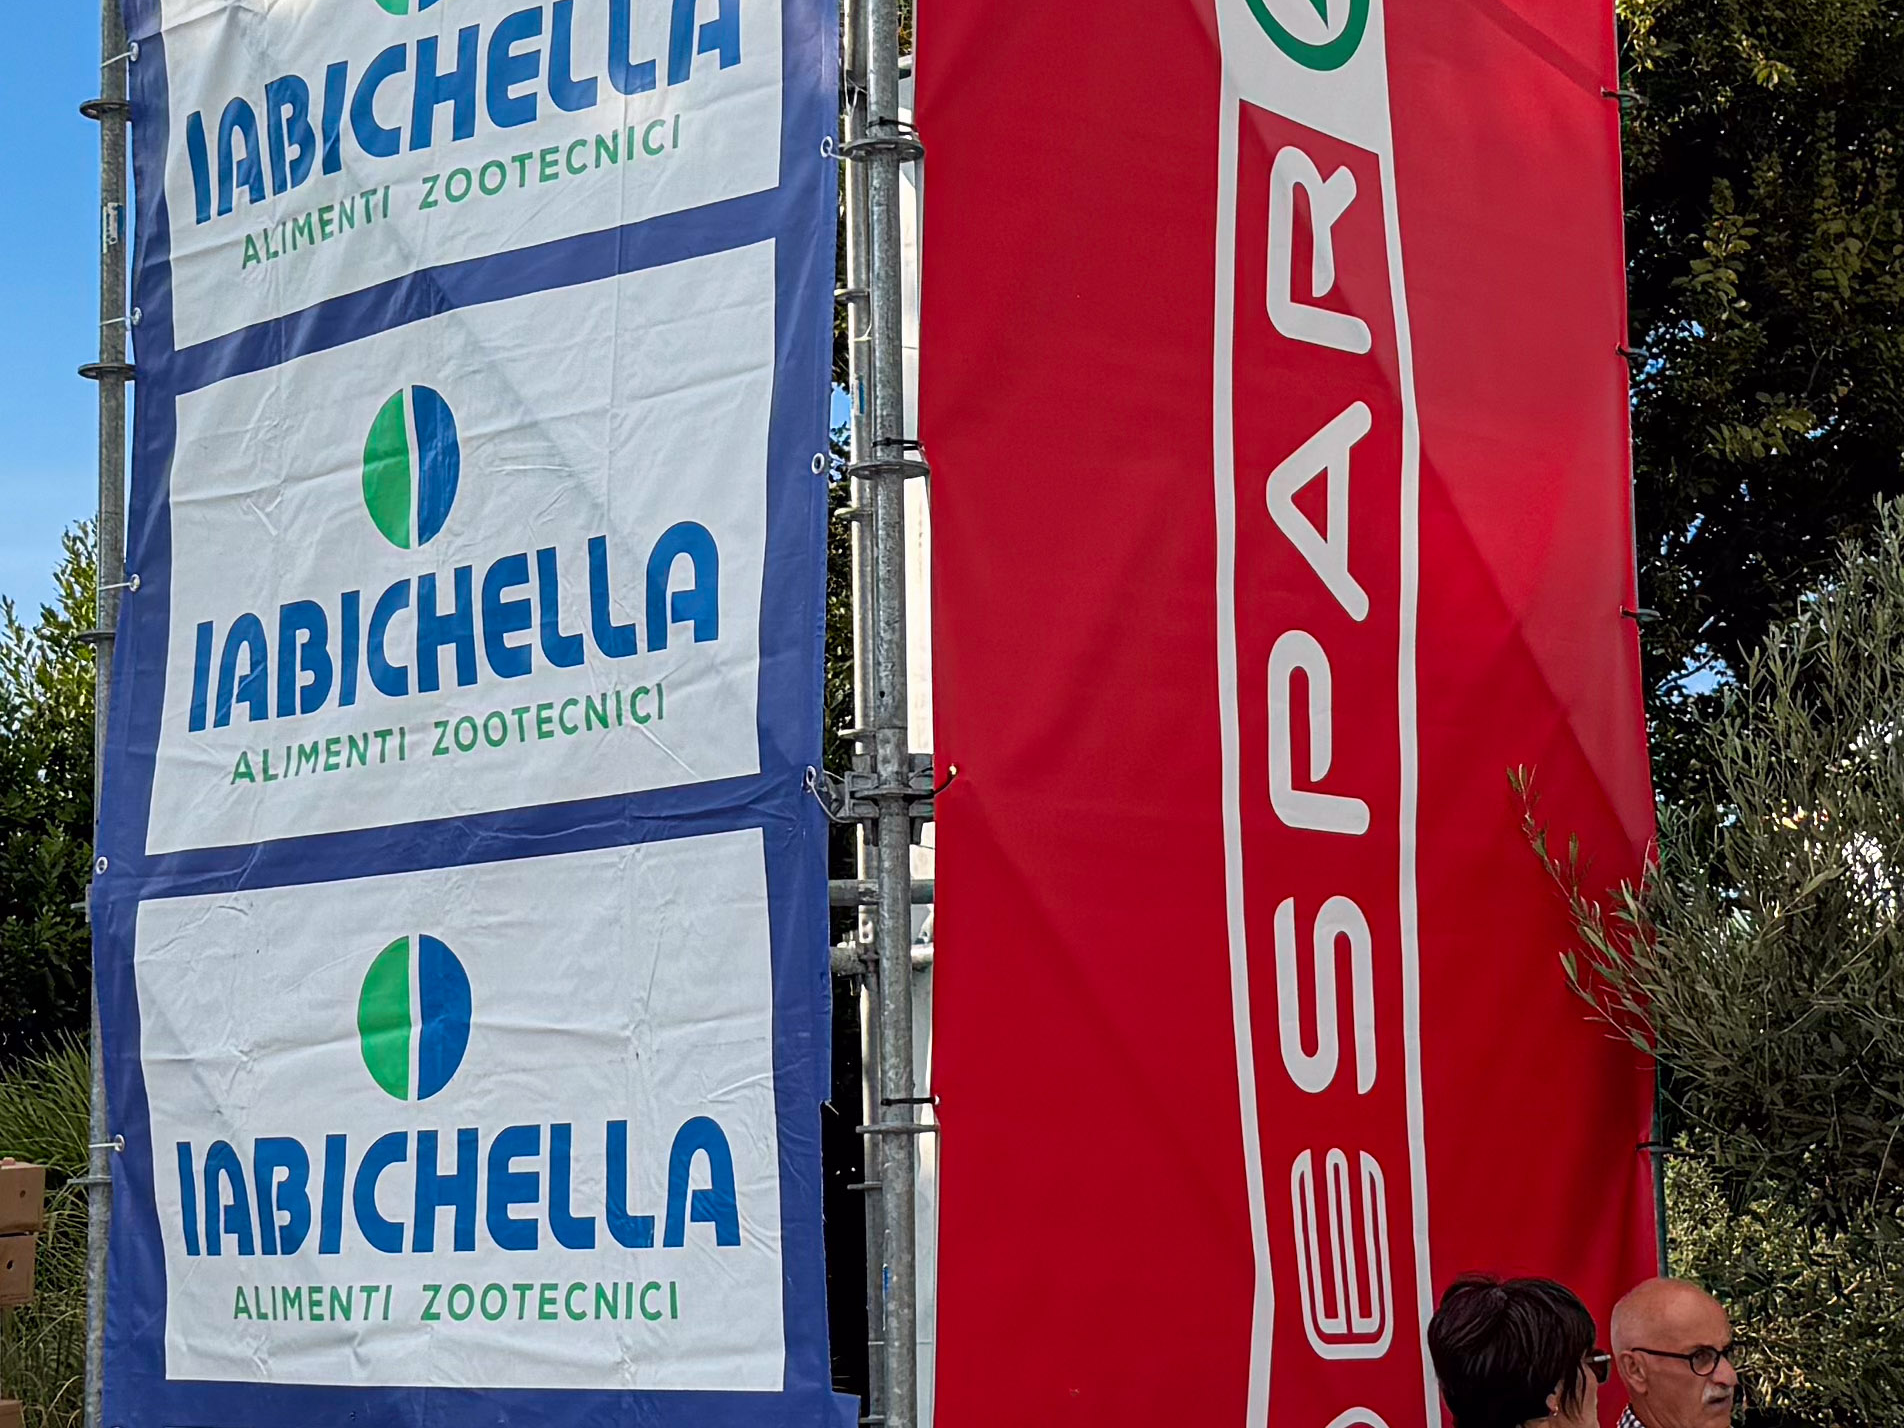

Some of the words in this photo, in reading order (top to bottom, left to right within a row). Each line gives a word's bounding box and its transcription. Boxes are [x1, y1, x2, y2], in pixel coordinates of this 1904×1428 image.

[241, 185, 391, 270] ALIMENTI
[420, 113, 682, 211] ZOOTECNICI
[188, 520, 720, 733] IABICHELLA
[230, 728, 407, 786] ALIMENTI
[432, 682, 666, 757] ZOOTECNICI
[176, 1115, 742, 1257] IABICHELLA
[233, 1285, 393, 1322] ALIMENTI
[421, 1281, 680, 1321] ZOOTECNICI
